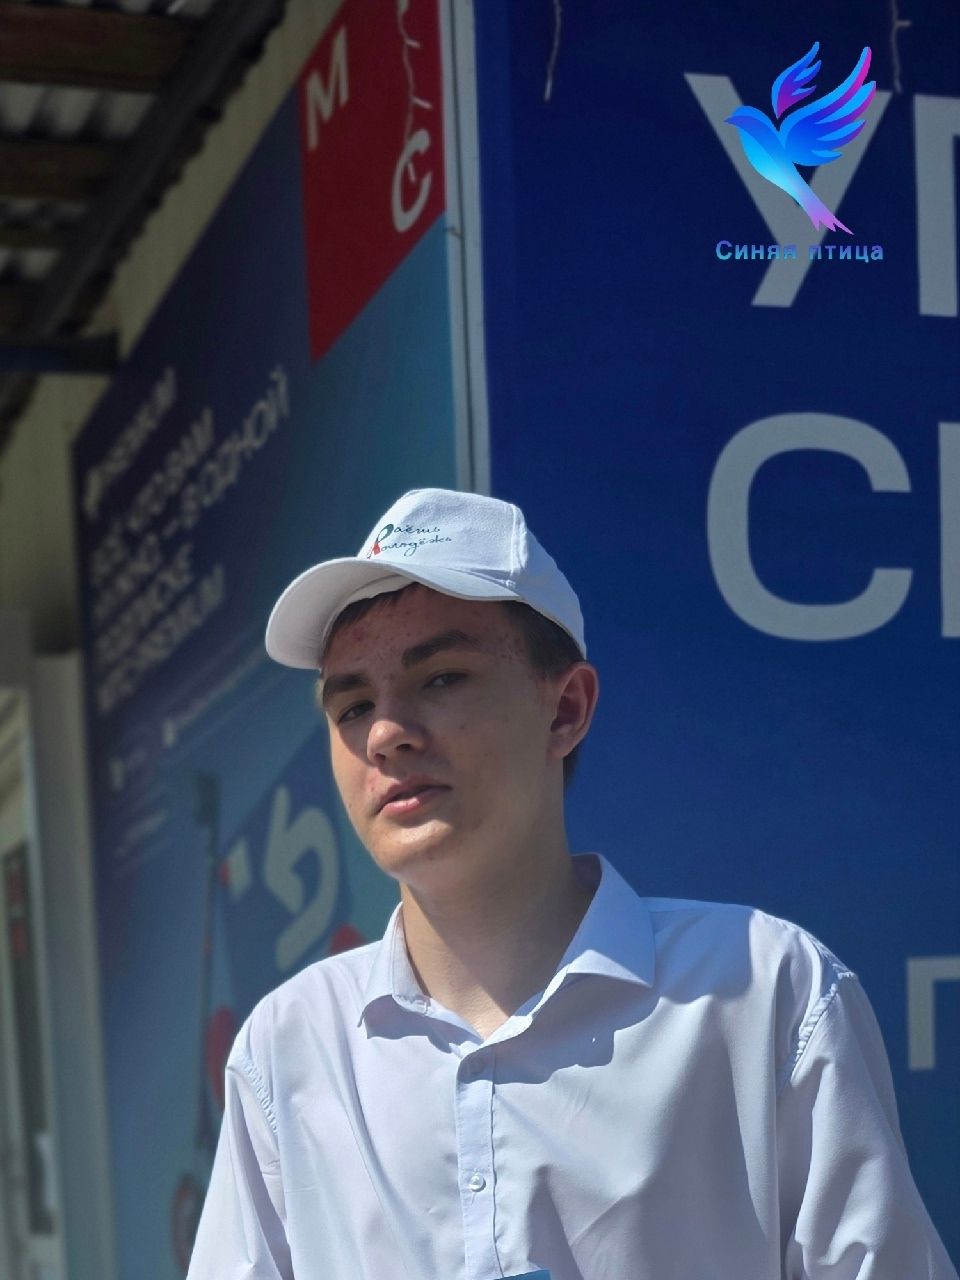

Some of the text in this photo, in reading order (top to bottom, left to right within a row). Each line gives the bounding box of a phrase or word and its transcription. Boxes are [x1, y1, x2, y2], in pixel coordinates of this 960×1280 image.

[305, 23, 350, 152] М
[391, 128, 432, 233] С
[684, 71, 960, 317] У
[707, 411, 960, 641] С
